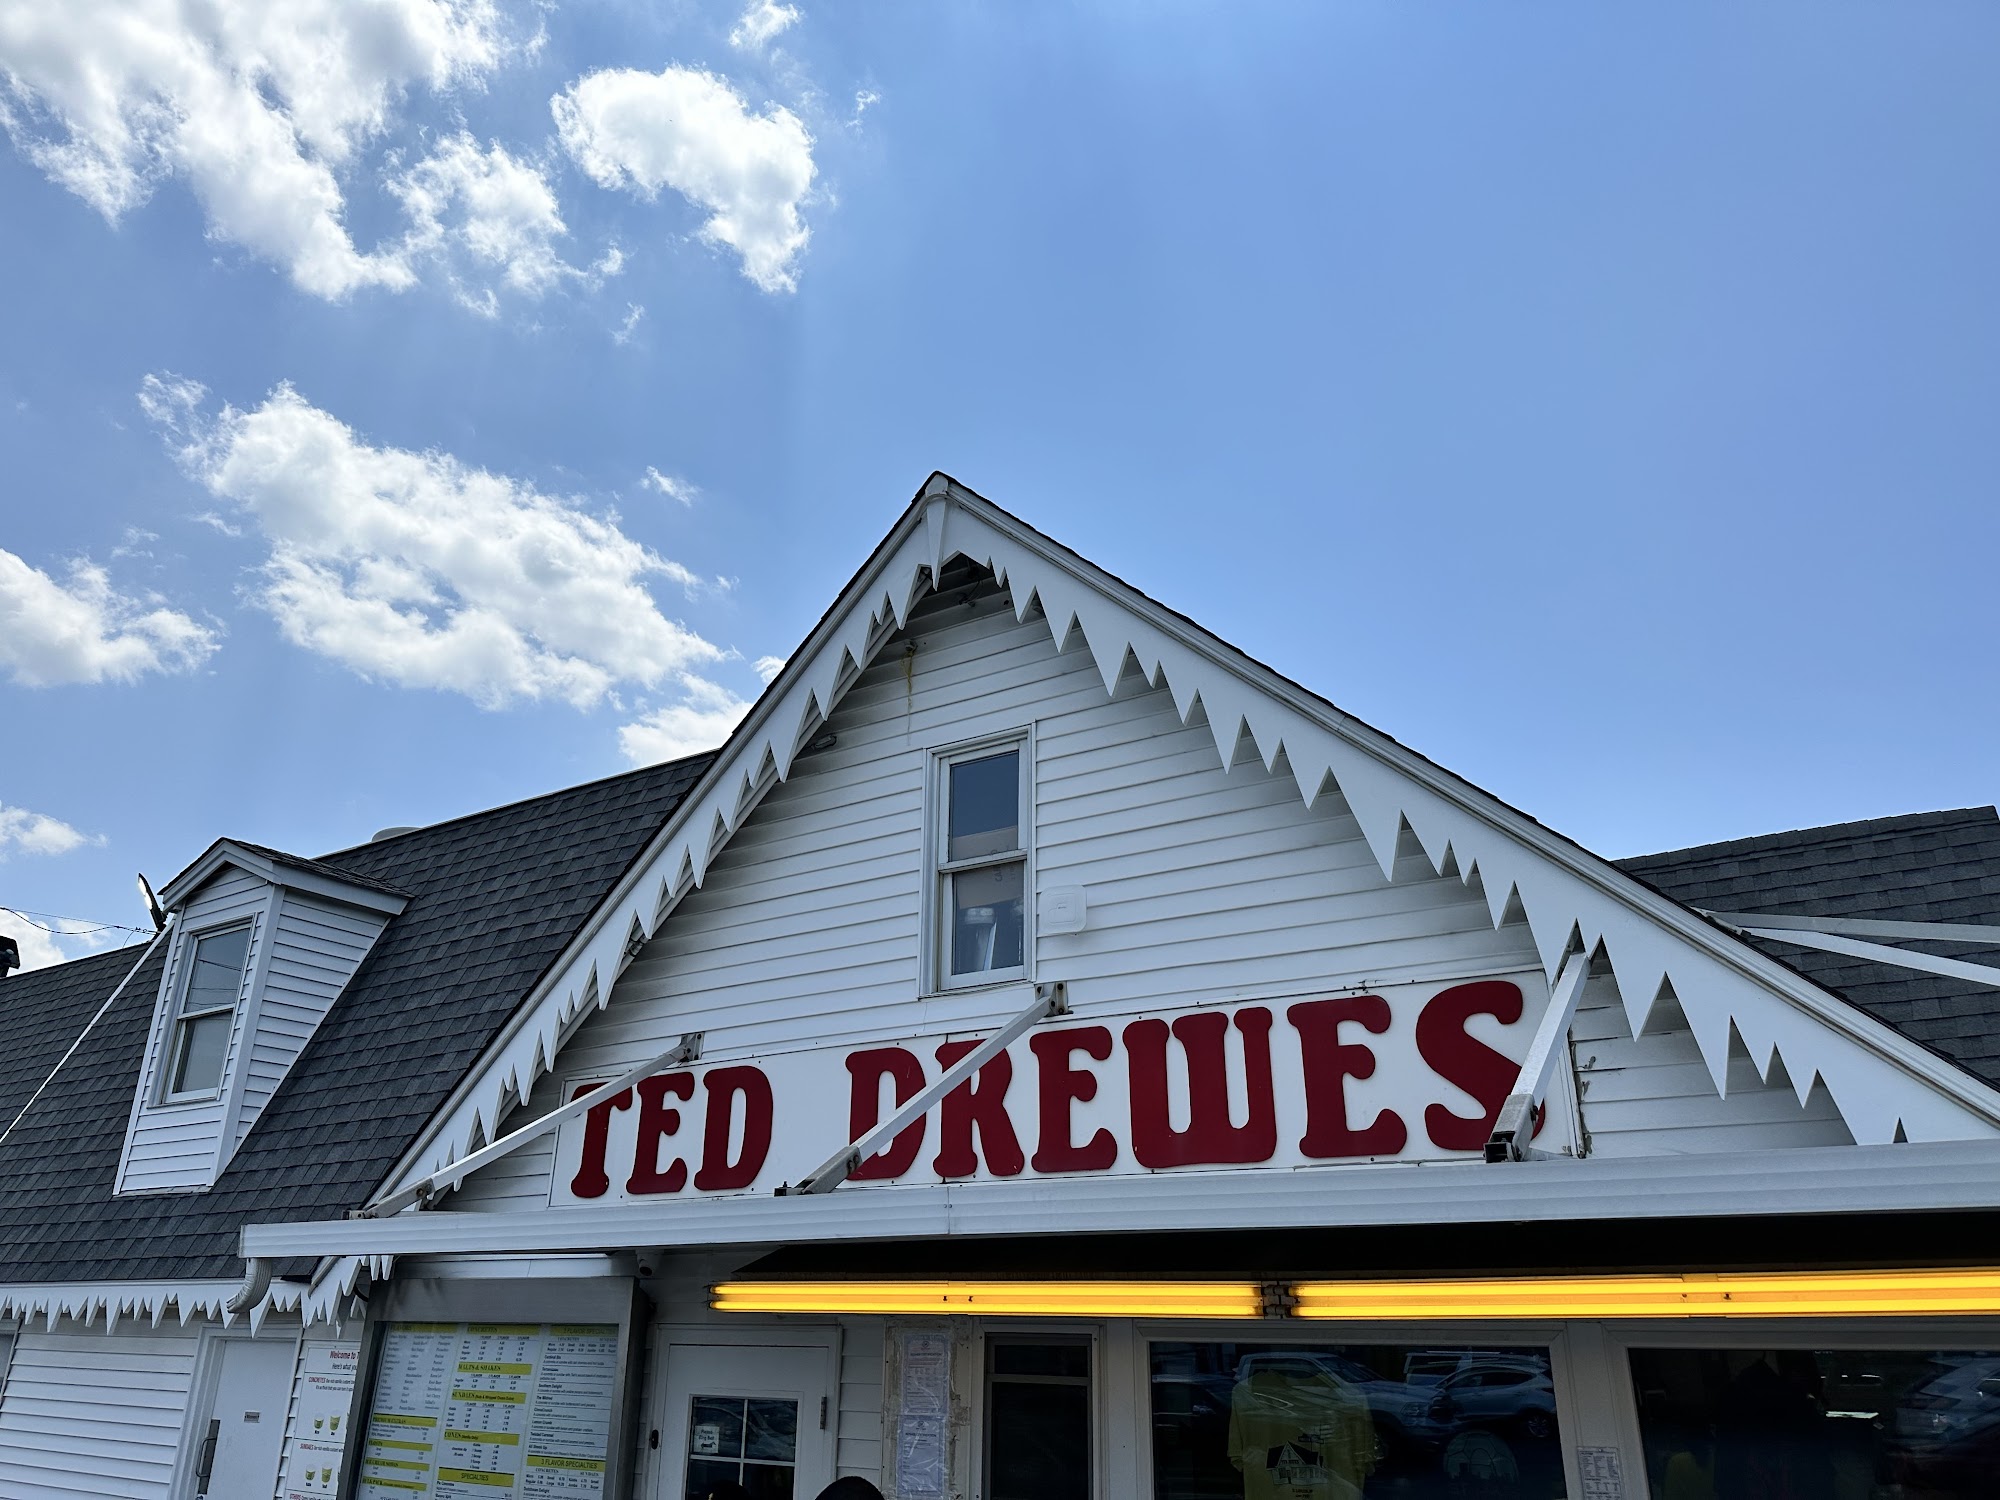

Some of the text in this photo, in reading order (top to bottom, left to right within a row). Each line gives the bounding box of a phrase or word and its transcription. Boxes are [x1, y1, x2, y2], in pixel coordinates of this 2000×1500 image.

[570, 981, 1546, 1199] TED DREWES
[329, 1351, 351, 1359] Welcome
[545, 1459, 565, 1467] FLAVOR
[565, 1460, 598, 1469] SPECIALTIES
[461, 1472, 489, 1481] SPECIALTIES
